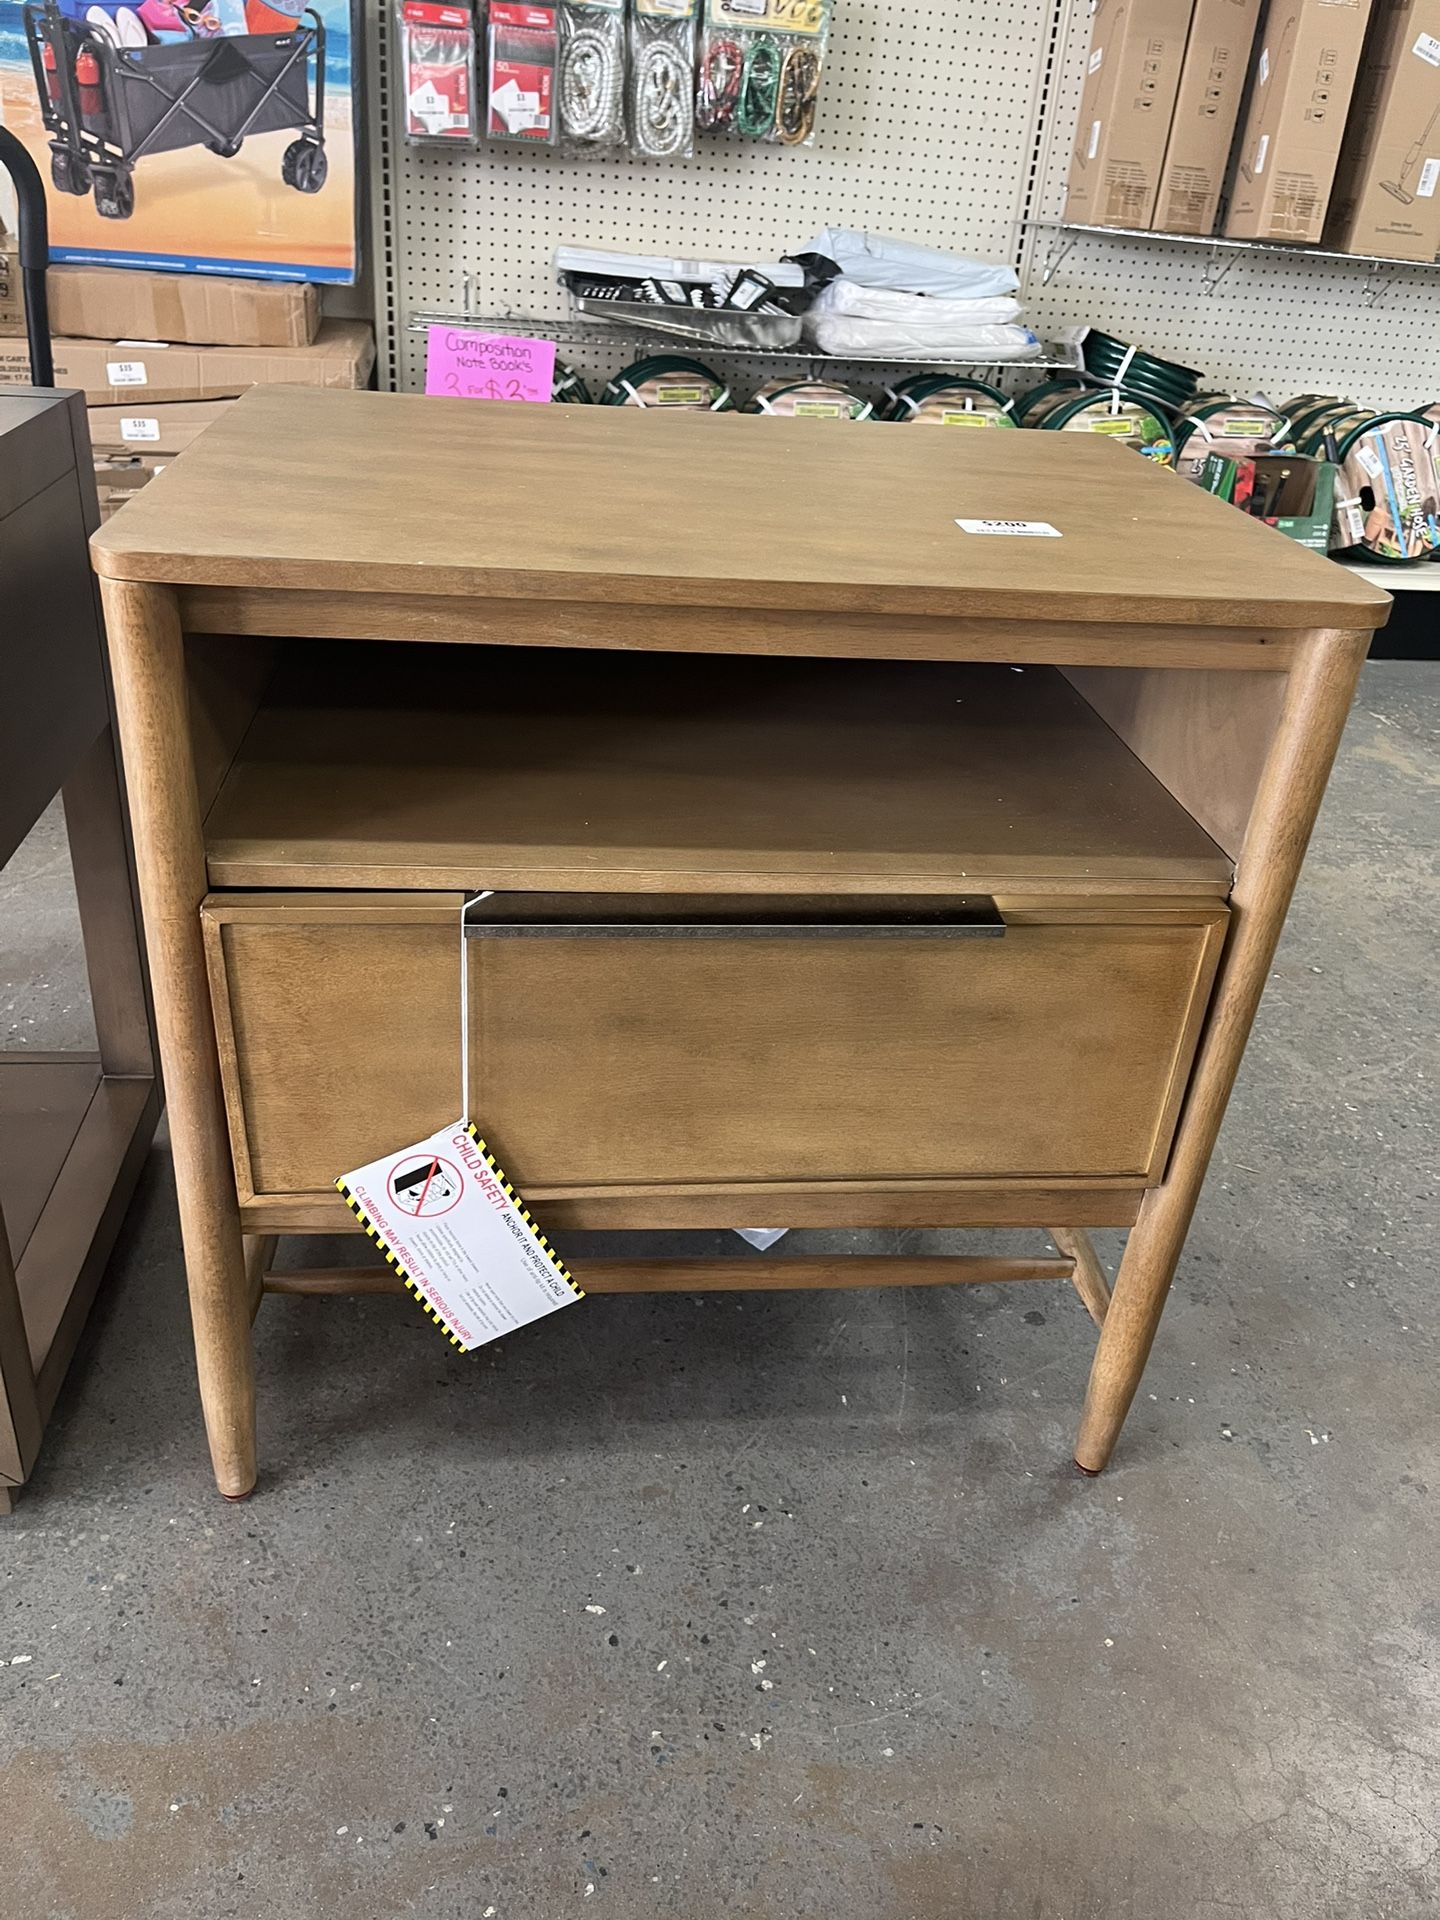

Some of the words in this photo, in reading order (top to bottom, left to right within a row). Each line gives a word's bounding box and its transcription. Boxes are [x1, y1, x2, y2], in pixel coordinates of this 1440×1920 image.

[445, 332, 532, 359] Composition
[1400, 458, 1423, 506] GARDEN
[1411, 507, 1428, 538] HOSE
[452, 1134, 481, 1170] CHILD
[474, 1169, 509, 1211] SAFETY
[502, 1212, 524, 1238] ANCHOR
[516, 1236, 528, 1244] IT
[520, 1241, 536, 1256] AND
[355, 1185, 387, 1229] CLIMBING
[385, 1228, 403, 1247] MAY
[398, 1246, 424, 1278] RESULT
[418, 1276, 431, 1287] IN
[426, 1287, 454, 1319] SERIOUS
[451, 1317, 474, 1341] INJURY
[530, 1254, 552, 1280] PROTECT
[545, 1276, 555, 1284] A
[548, 1280, 565, 1297] CHILD
